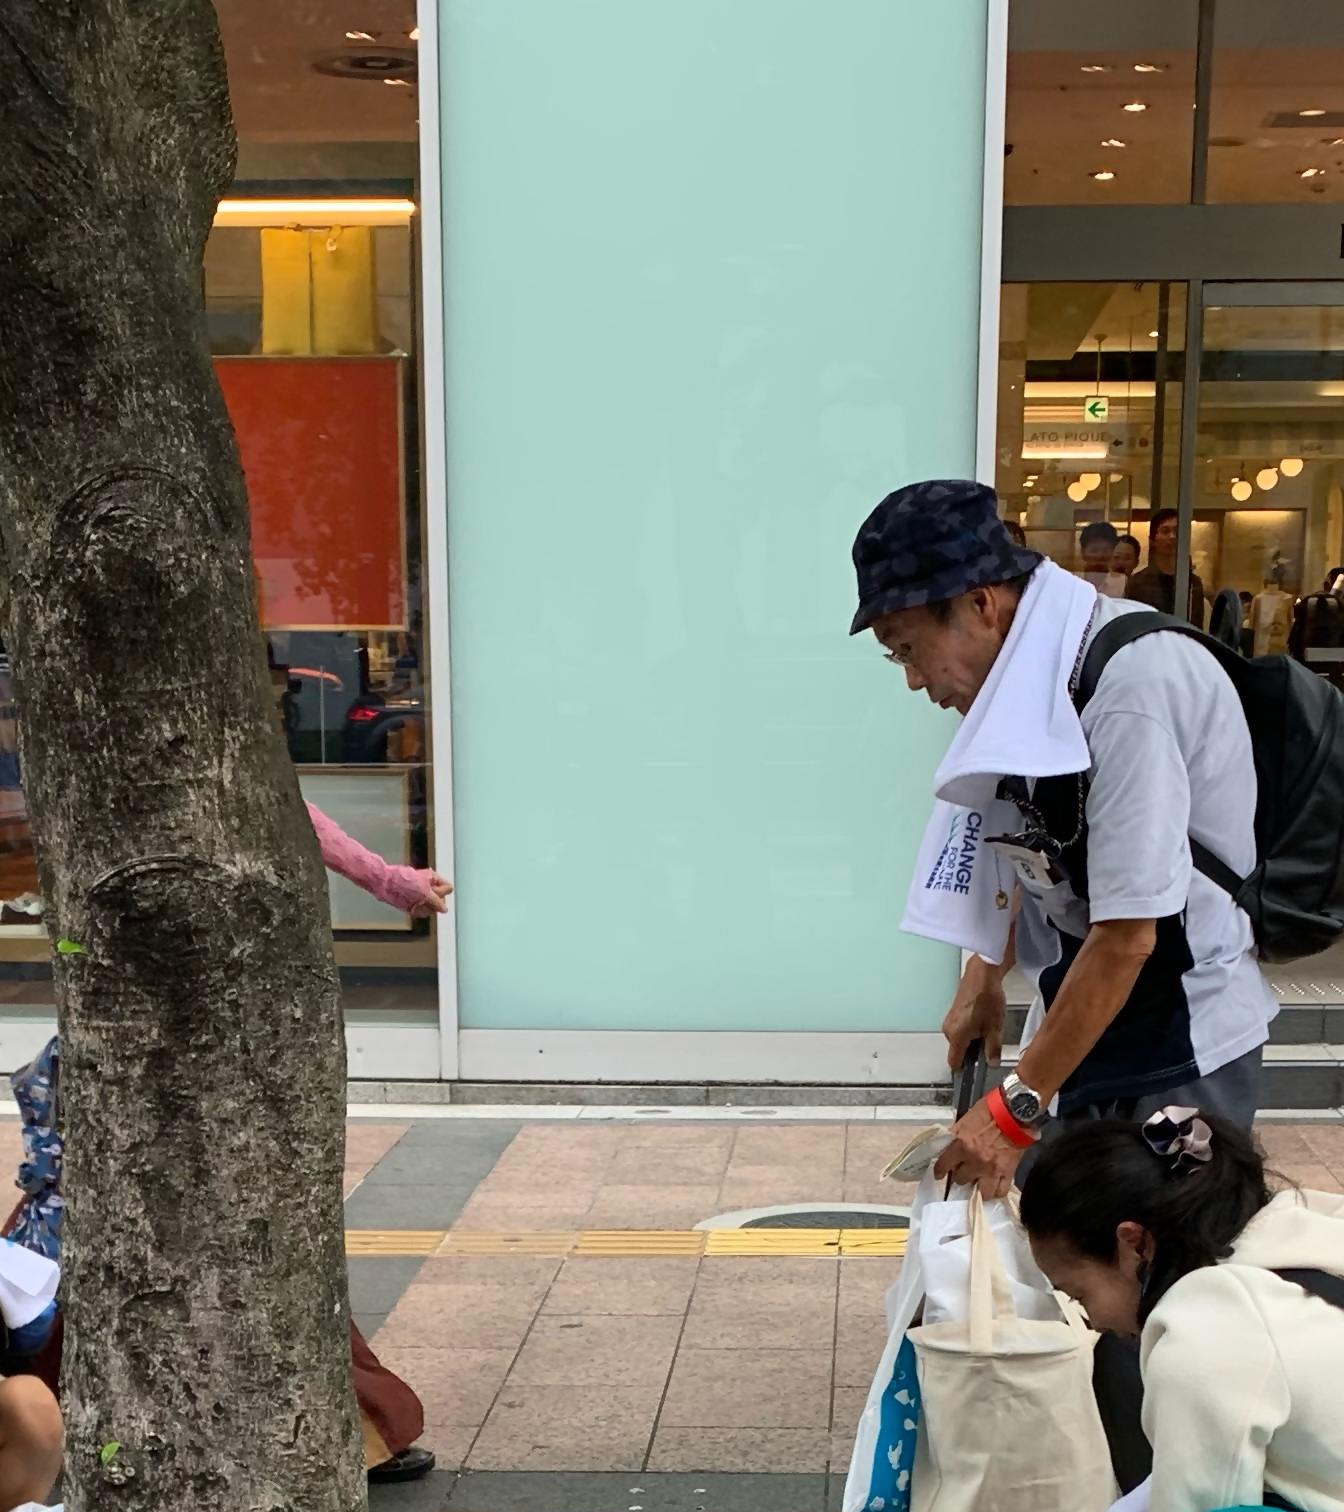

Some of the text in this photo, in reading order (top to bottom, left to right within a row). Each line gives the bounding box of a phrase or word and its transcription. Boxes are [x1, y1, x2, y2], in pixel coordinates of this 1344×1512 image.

[942, 847, 958, 891] FOR THE
[954, 811, 982, 895] CHANGE
